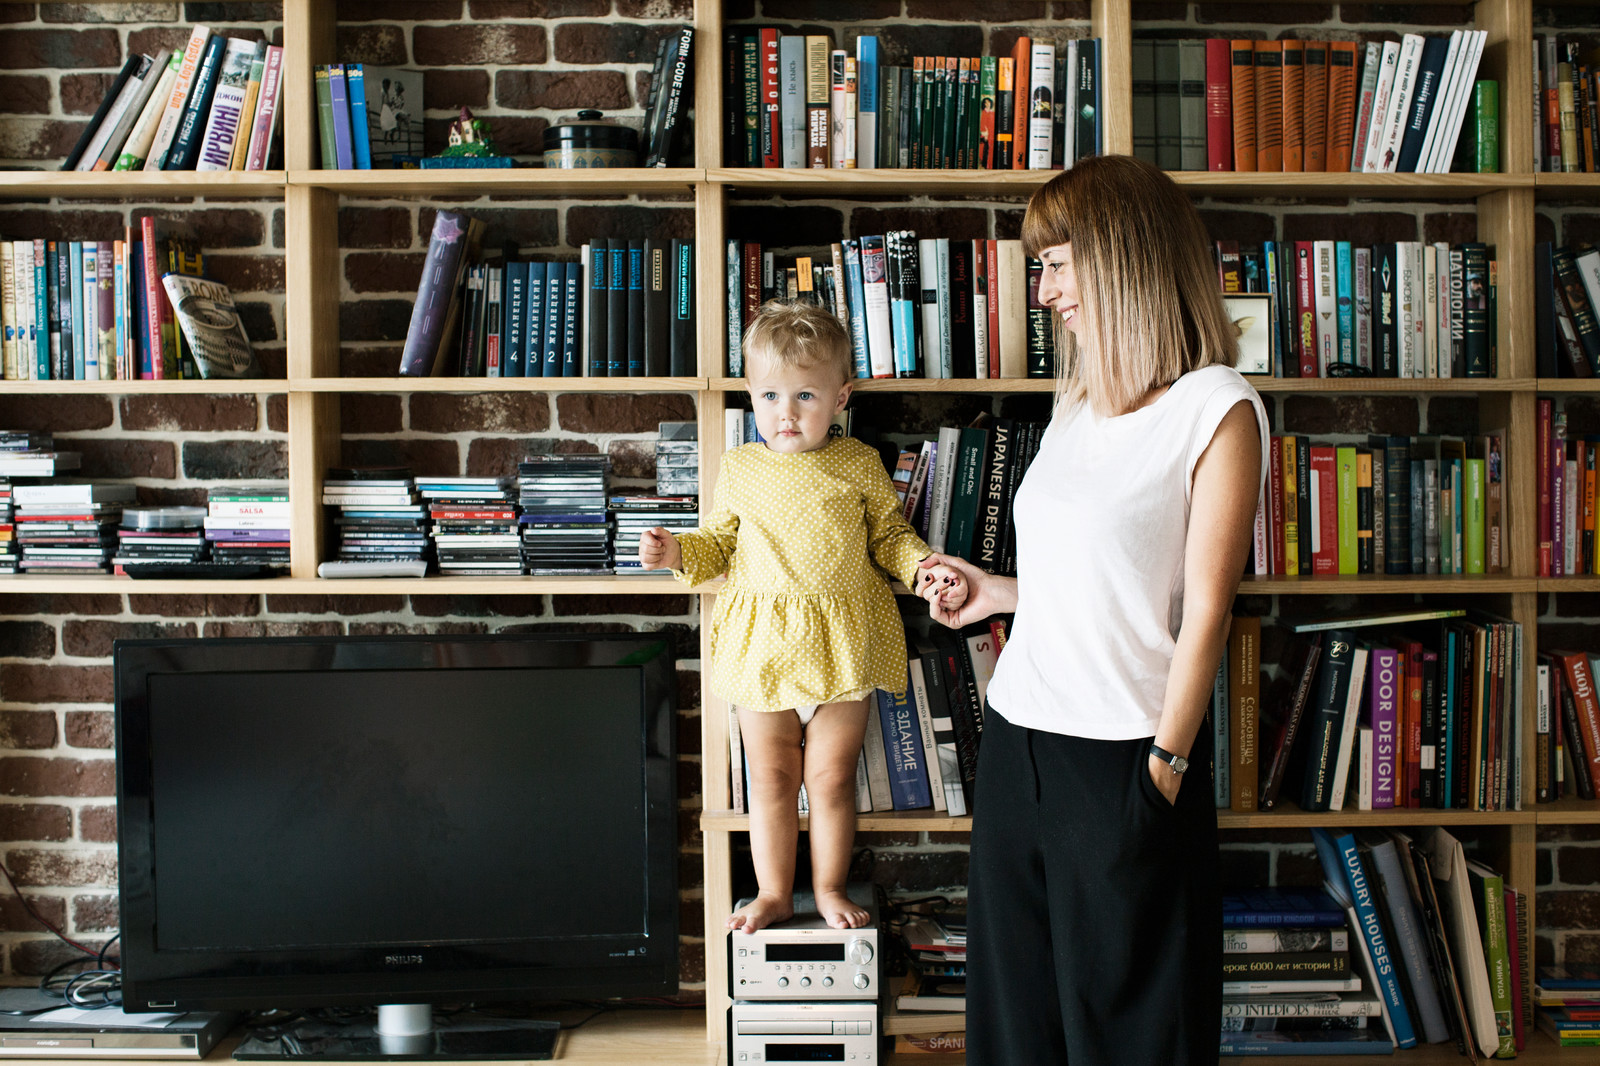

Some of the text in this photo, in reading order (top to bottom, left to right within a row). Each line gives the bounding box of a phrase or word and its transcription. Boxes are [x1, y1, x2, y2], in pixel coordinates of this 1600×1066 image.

[184, 37, 204, 66] Gypsy
[672, 30, 692, 88] FORM+CODE
[767, 41, 778, 112] Богема
[789, 84, 796, 95] Не
[170, 92, 187, 109] Run
[178, 110, 197, 146] ГИБЕЛЬ
[4, 259, 13, 304] ПИКТЫ
[190, 281, 231, 303] ROME
[954, 252, 967, 323] Конан Дойль
[1450, 251, 1463, 340] ПАТОЛОГИИ
[511, 278, 522, 344] ЖВАНЕЦКИЙ
[531, 279, 541, 345] ЖВАНЕЦКИЙ
[549, 278, 559, 344] ЖВАНЕЦКИЙ
[566, 278, 576, 345] ЖВАНЕЦКИЙ
[1403, 270, 1412, 376] БЫКОВ СПИСАННЫЕ
[510, 351, 518, 362] 4
[530, 352, 538, 364] 3
[548, 351, 556, 363] 2
[566, 351, 573, 362] 1
[852, 316, 866, 372] В. НАБОКОВ
[1342, 338, 1351, 363] ПЕЛЕВ
[982, 425, 1009, 562] JAPANESE DESIGN
[1374, 511, 1383, 555] ЛЕССИНГ
[1573, 662, 1592, 698] ЙОГА
[917, 686, 933, 749] Ванные комнаты
[968, 681, 983, 734] МАГРИТТ
[1290, 685, 1309, 724] MOROCCAN
[1378, 656, 1393, 791] DOOR DESIGN
[888, 712, 902, 772] НУЖНО УВИДЕТЬ
[896, 710, 917, 771] ЗДАНИЕ
[1244, 697, 1255, 764] СОКРОВИЩА
[1285, 725, 1295, 745] STYLE
[1344, 847, 1400, 1007] LUXURY HOUSES SEASIDE
[385, 955, 423, 965] PHILIPS
[1250, 962, 1273, 971] 6000
[1293, 962, 1330, 971] истории
[1496, 959, 1504, 998] БОТАНИКА
[1245, 1003, 1309, 1016] INTERIORS
[930, 1038, 966, 1048] SPANI
